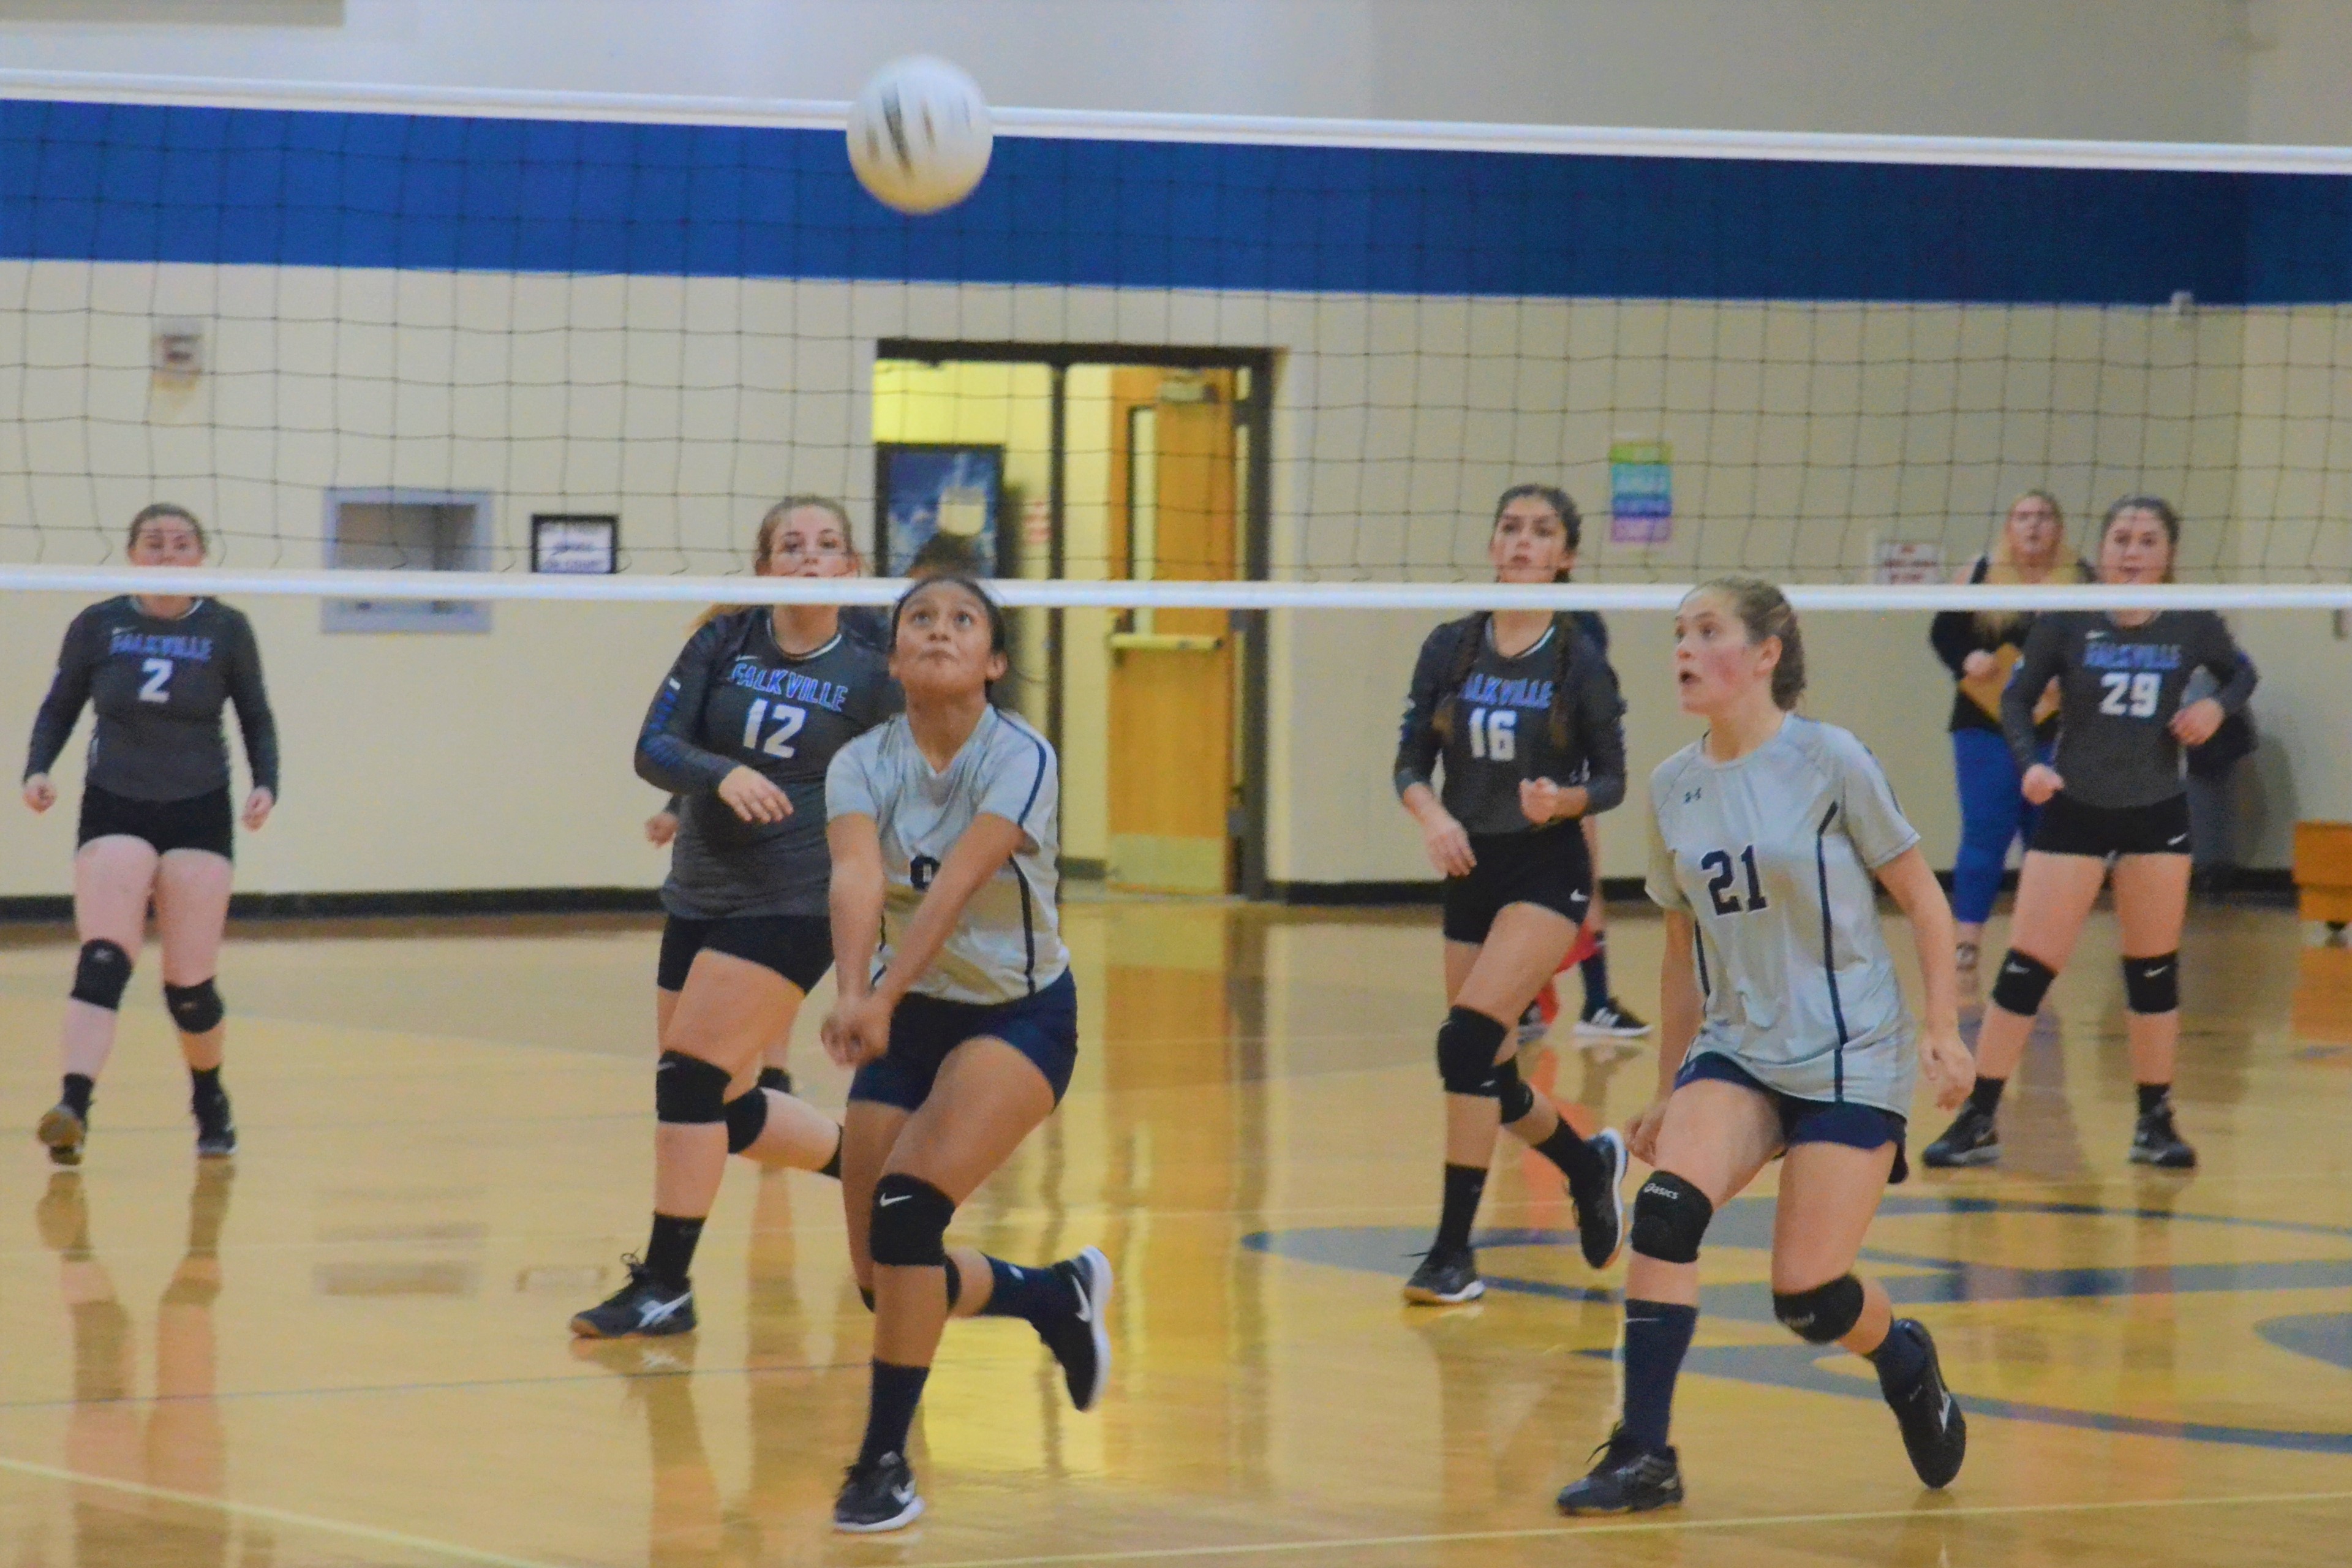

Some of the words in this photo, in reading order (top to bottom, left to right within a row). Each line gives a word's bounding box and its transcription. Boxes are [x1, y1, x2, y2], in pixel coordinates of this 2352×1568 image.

[138, 657, 174, 703] 2
[729, 663, 848, 712] FALKVILLE
[1457, 673, 1554, 709] ALKVILLE
[2100, 672, 2162, 717] 29
[743, 698, 807, 758] 12
[1469, 707, 1517, 761] 16
[1700, 843, 1768, 916] 21
